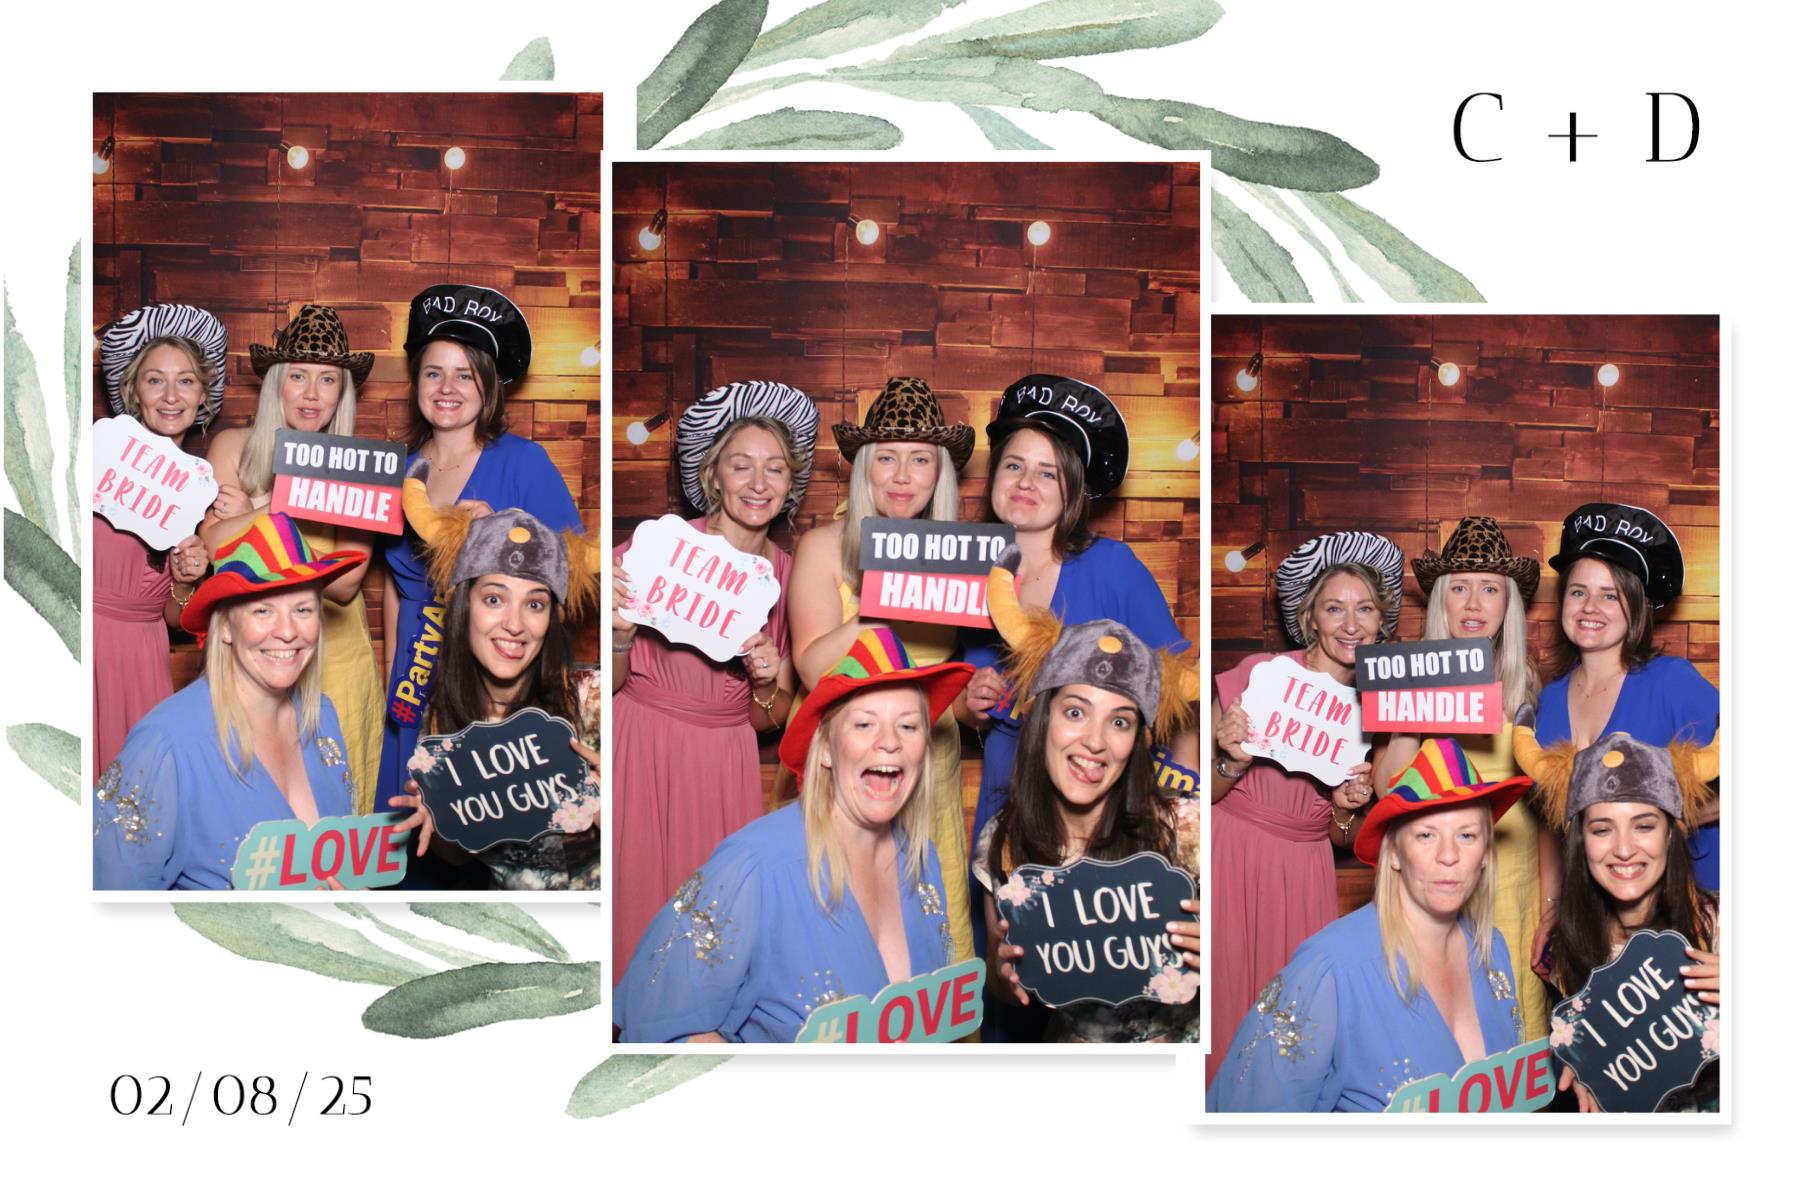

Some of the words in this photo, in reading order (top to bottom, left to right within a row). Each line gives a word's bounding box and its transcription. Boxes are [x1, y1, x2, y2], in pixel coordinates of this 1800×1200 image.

[422, 296, 456, 315] BAD
[1016, 386, 1053, 405] BAD
[119, 435, 190, 493] TEAM
[283, 441, 325, 468] TOO
[328, 446, 370, 472] HOT
[372, 450, 398, 475] TO
[97, 467, 182, 531] BRIDE
[287, 476, 393, 523] HANDLE
[1574, 515, 1607, 533] BAD
[669, 536, 749, 596] TEAM
[871, 532, 920, 560] TOO
[924, 534, 972, 561] HOT
[645, 575, 743, 639] BRIDE
[879, 571, 991, 617] HANDL
[391, 594, 448, 723] #PartyA
[1364, 655, 1407, 681] TOO
[1410, 651, 1453, 677] HOT
[1455, 648, 1485, 673] TO
[1283, 675, 1353, 726] TEAM
[1378, 691, 1485, 723] HANDLE
[444, 757, 463, 787] I
[470, 734, 550, 780] LOVE
[1264, 711, 1350, 765] BRIDE
[449, 790, 503, 826] YOU
[506, 773, 578, 812] GUYS
[245, 824, 401, 889] #LOVE
[1041, 891, 1056, 929] I
[1073, 882, 1161, 926] LOVE
[1035, 938, 1096, 975] YOU
[1103, 932, 1185, 971] GUYS
[1580, 1018, 1607, 1047] I
[1601, 956, 1675, 1028] LOVE
[1602, 1038, 1658, 1092] YOU
